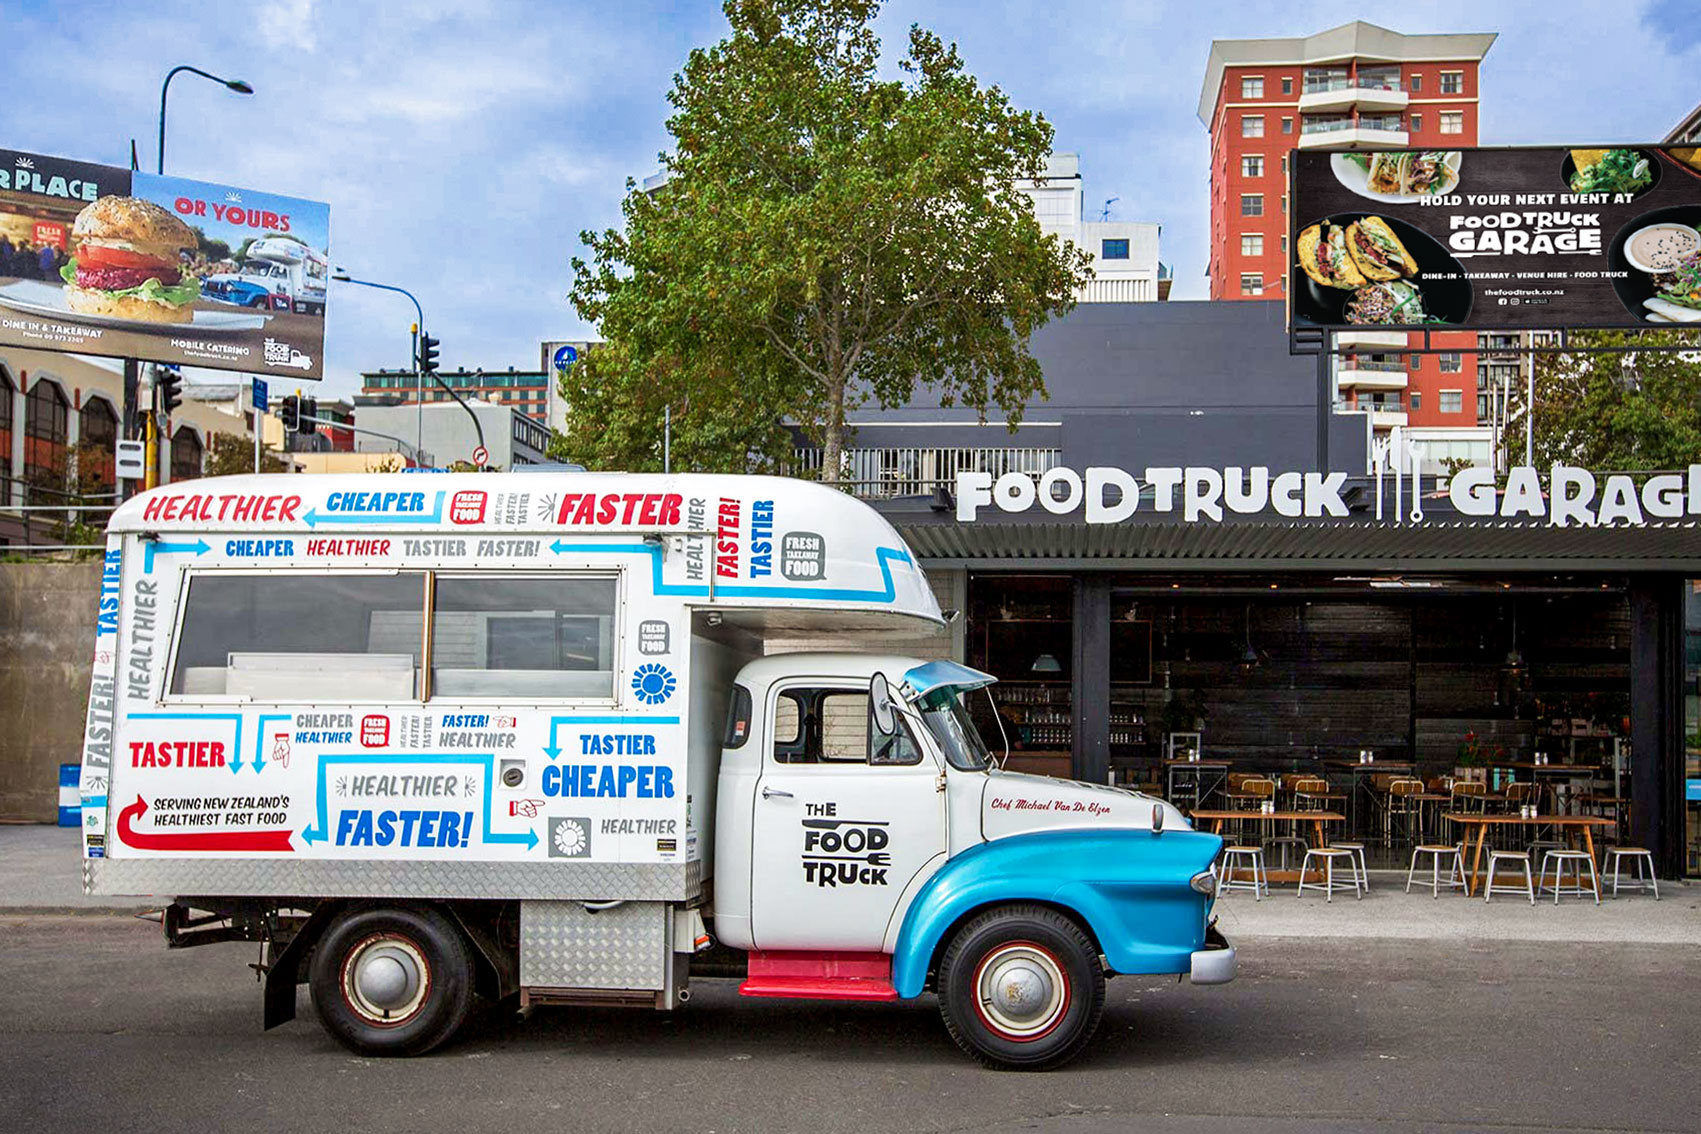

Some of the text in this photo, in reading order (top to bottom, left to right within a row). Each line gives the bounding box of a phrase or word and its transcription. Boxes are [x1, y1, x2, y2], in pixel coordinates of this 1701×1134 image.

[15, 169, 98, 201] PLACE
[1420, 193, 1634, 206] HOLD YOUR NEXT EVENT AT
[174, 197, 290, 232] OR YOURS
[1449, 229, 1601, 255] GARAGE
[1464, 272, 1509, 280] TAKEAWAY
[1574, 271, 1598, 279] FOOD
[2, 320, 26, 330] DINE
[28, 323, 39, 331] IN
[51, 325, 103, 338] TAKEAWAY
[171, 339, 249, 356] MOBILE CATERING
[142, 495, 302, 522] HEALTHIER
[326, 492, 425, 512] CHEAPER
[518, 493, 530, 525] TASTIER
[557, 493, 683, 525] FASTER
[453, 508, 481, 520] FOOD
[686, 497, 706, 581] HEALTHIER
[717, 497, 741, 578] FASTER!
[750, 500, 774, 578] TASTIER
[786, 537, 819, 550] FRESH
[226, 539, 541, 557] CHEAPER HEALTHIER TASTIER FASTER!
[786, 551, 819, 559] TAKEAWAY
[785, 560, 819, 576] FOOD
[96, 549, 121, 637] TASTIER
[127, 578, 158, 701] HEALTHIER
[641, 640, 666, 652] FOOD
[86, 673, 114, 769] FASTER!
[296, 714, 353, 728] CHEAPER
[442, 715, 489, 727] FASTER!
[295, 731, 352, 744] HEALTHIER
[363, 733, 386, 745] FOOD
[410, 715, 420, 748] FASTER!
[423, 715, 432, 748] TASTIER
[439, 732, 516, 748] HEALTHIER
[580, 734, 656, 755] TASTIER
[129, 742, 226, 768] TASTIER
[351, 775, 458, 798] HEALTHIER
[542, 765, 675, 798] CHEAPER
[153, 794, 290, 811] SERVING NEW ZEALAND'S
[805, 802, 836, 816] THE
[991, 798, 1111, 816] Chef Michael Van De Elzen
[154, 812, 287, 827] HEALTHIEST FAST FOOD
[335, 809, 474, 848] FASTER!
[601, 819, 677, 835] HEALTHIER
[805, 828, 889, 853] FOOD
[803, 862, 888, 888] TRUCK
